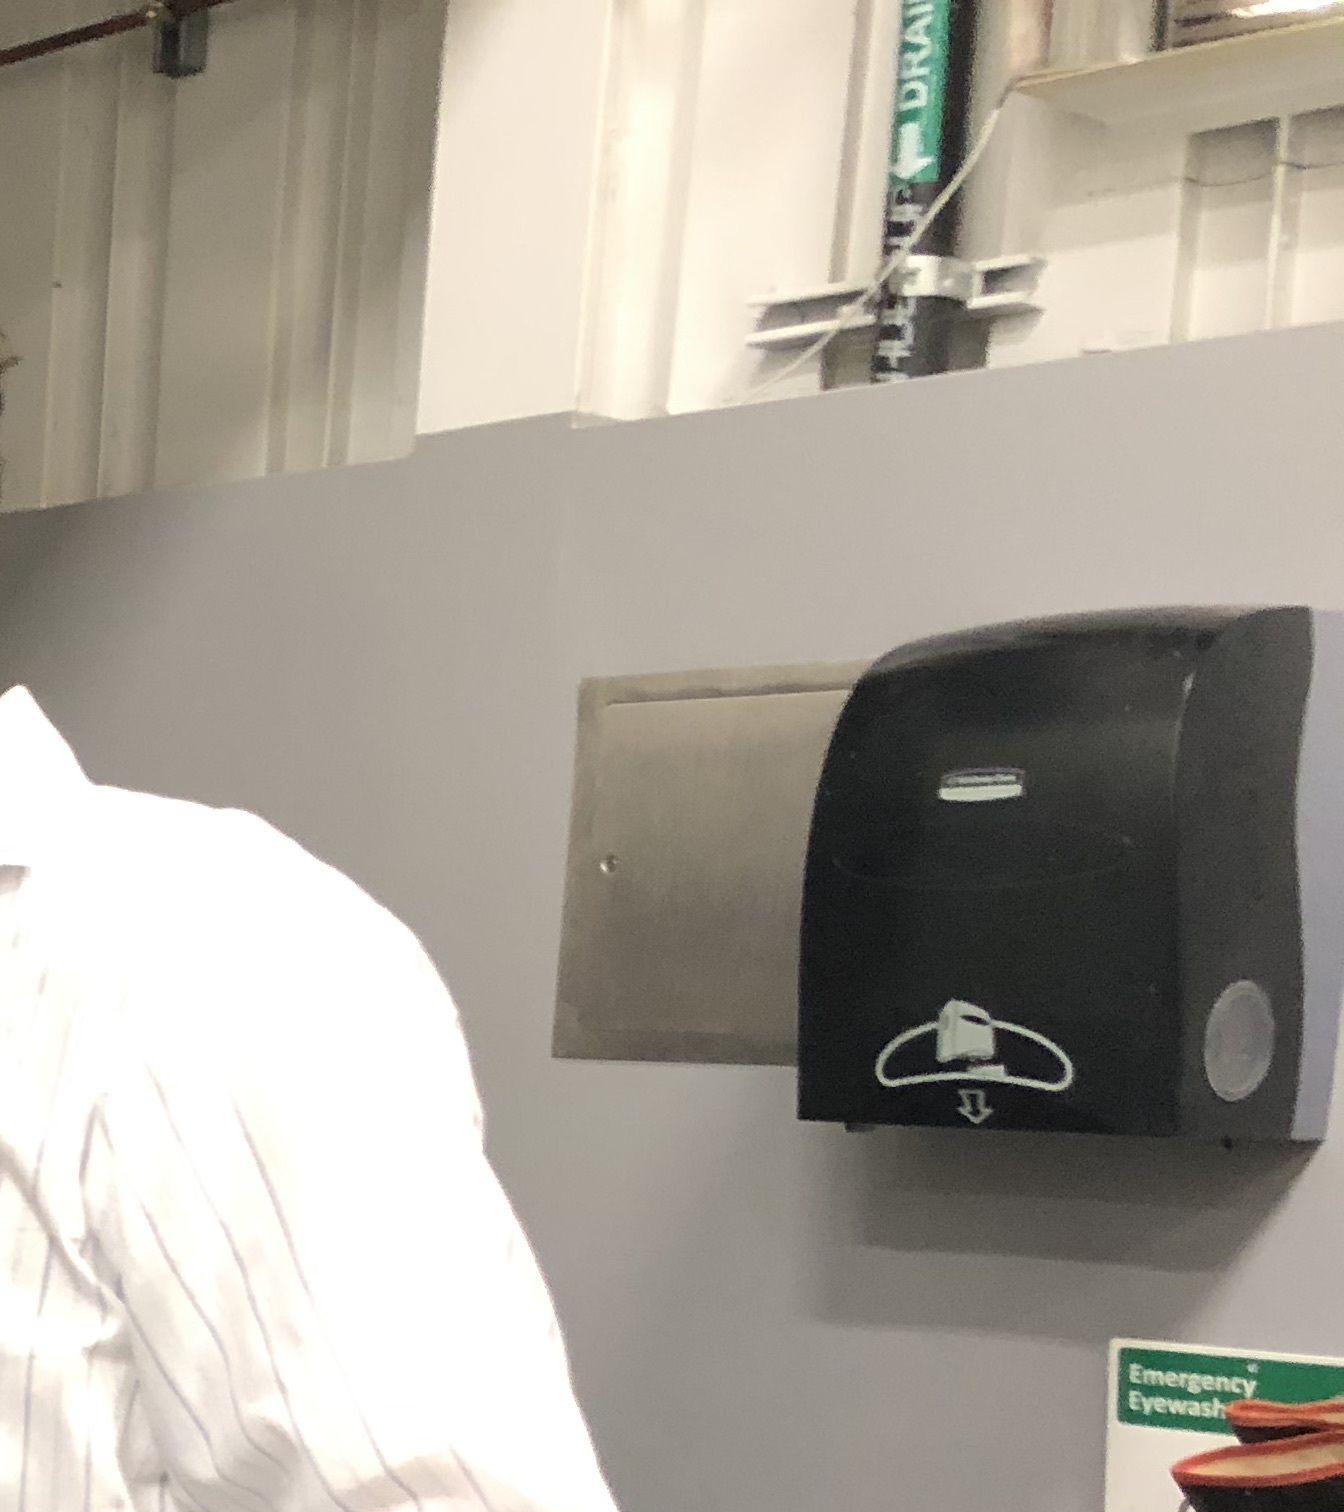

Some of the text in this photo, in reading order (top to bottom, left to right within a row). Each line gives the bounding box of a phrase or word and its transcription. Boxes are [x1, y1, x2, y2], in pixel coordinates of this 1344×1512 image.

[897, 0, 935, 109] DRAI
[1128, 1363, 1257, 1398] Emergency
[1128, 1390, 1227, 1419] Eyewash
